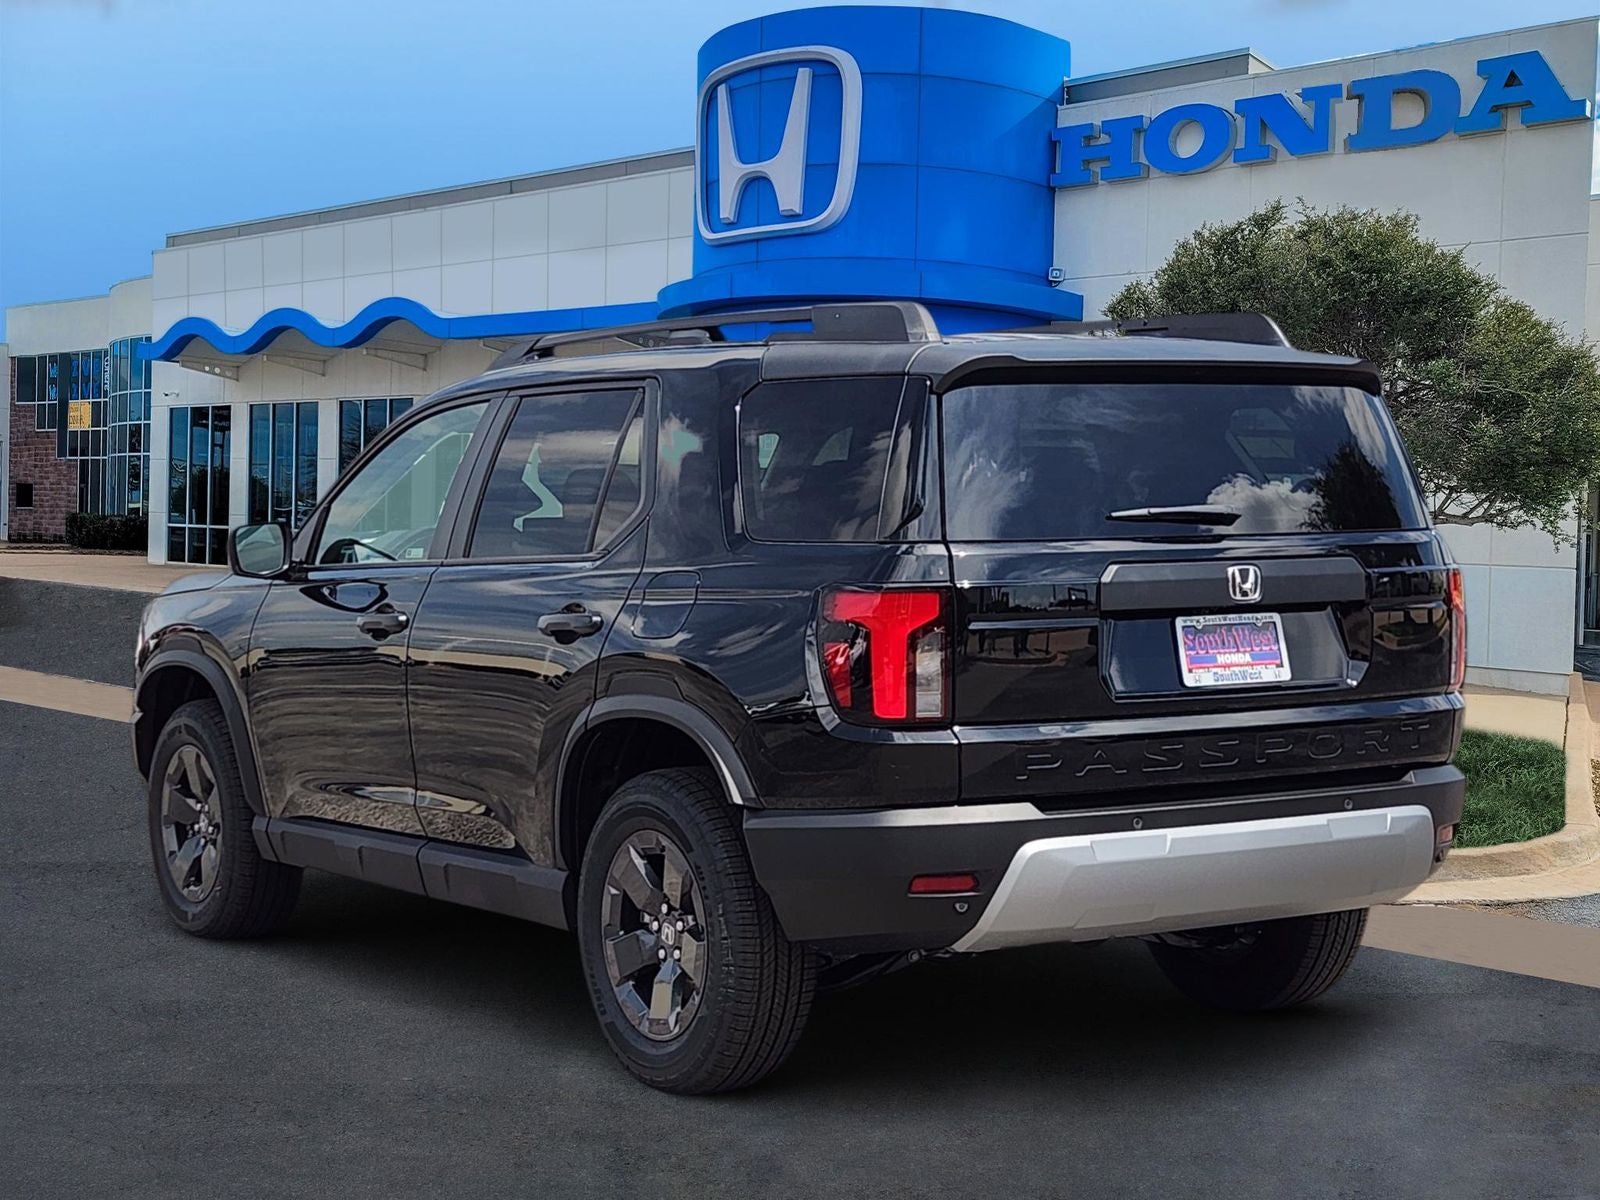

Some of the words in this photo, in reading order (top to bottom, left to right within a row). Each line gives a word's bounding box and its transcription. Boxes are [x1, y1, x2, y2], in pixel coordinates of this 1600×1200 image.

[1050, 50, 1592, 188] HONDA
[1216, 653, 1252, 664] HONDA
[1016, 722, 1431, 780] PASSPORT
